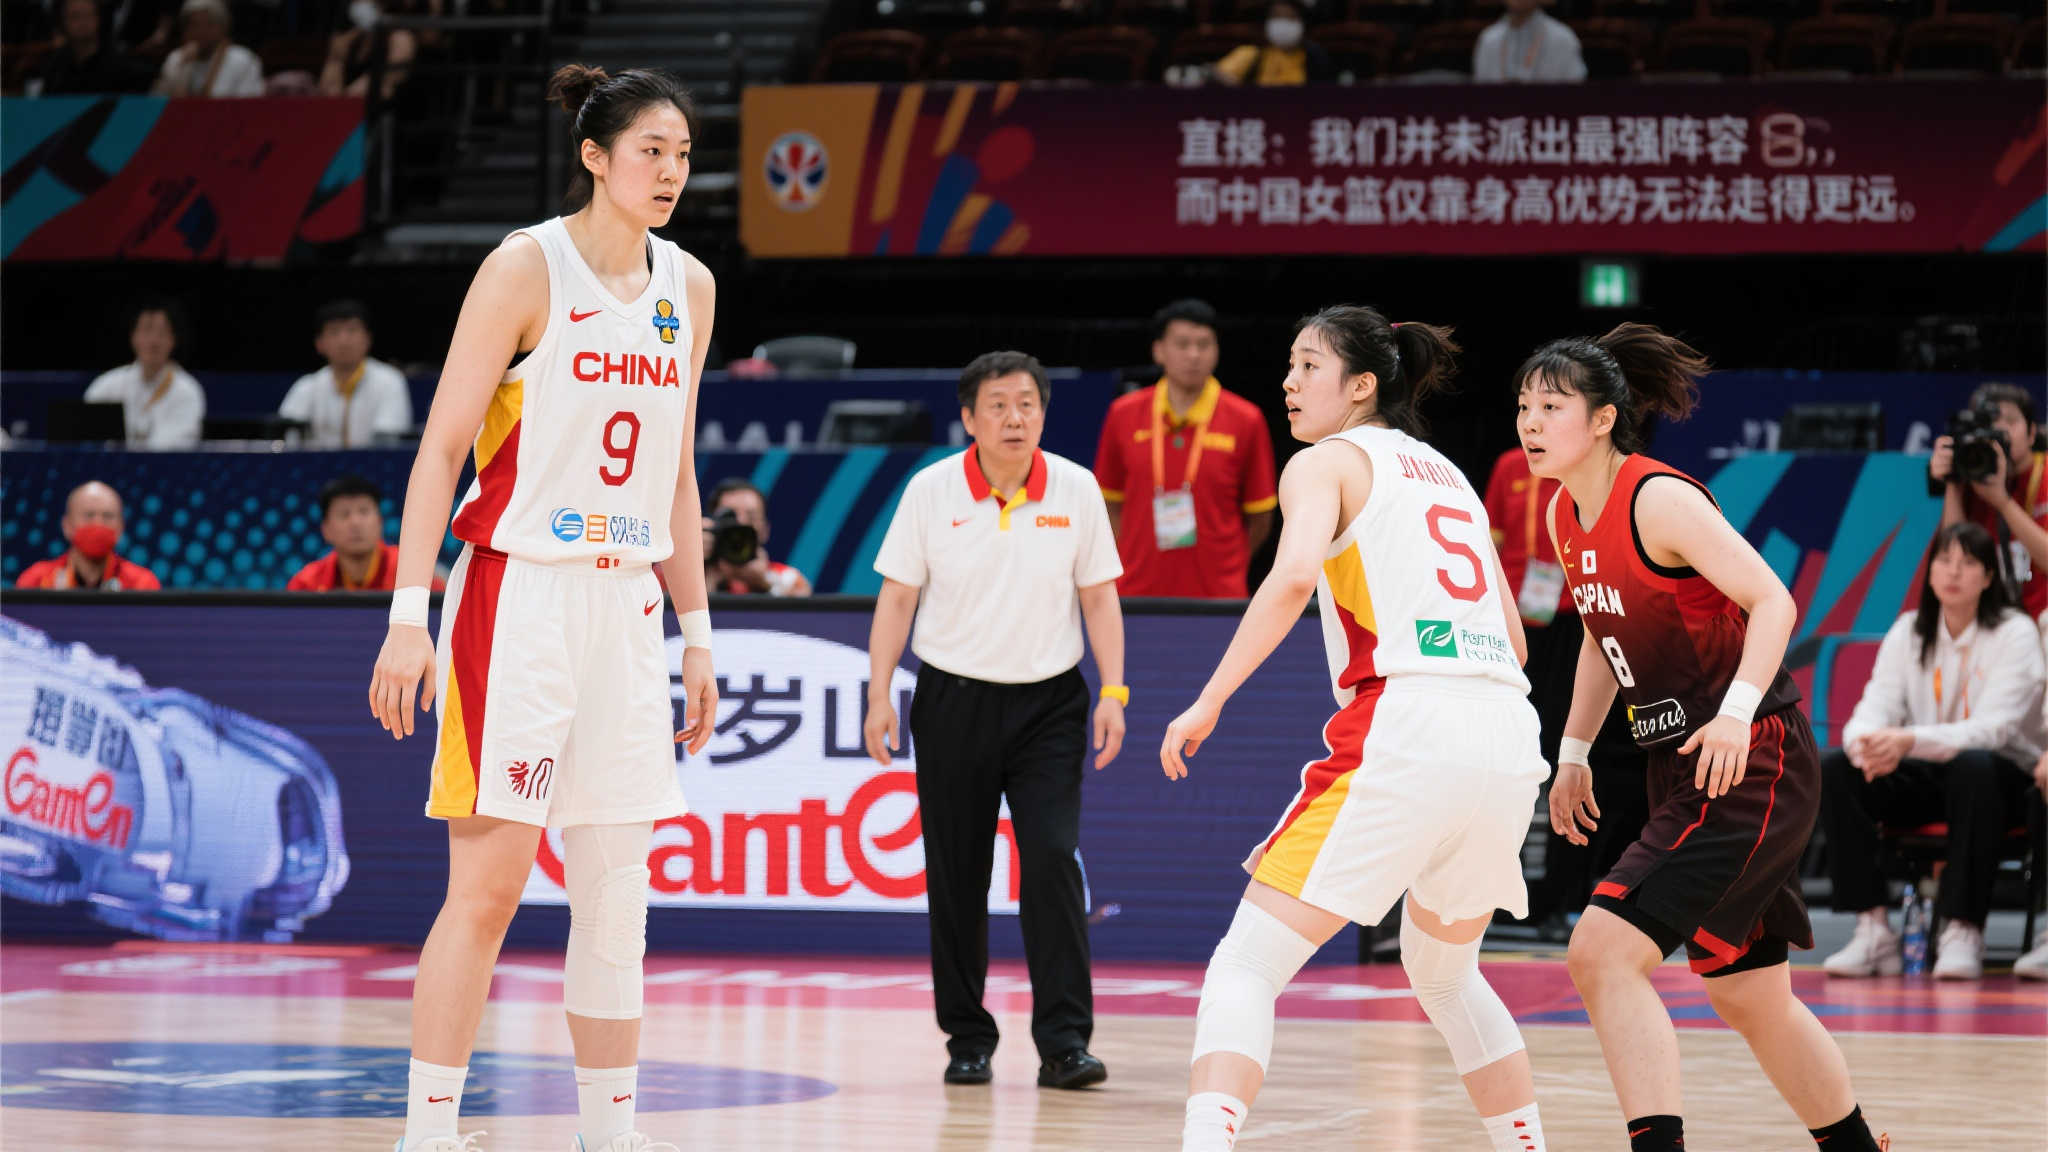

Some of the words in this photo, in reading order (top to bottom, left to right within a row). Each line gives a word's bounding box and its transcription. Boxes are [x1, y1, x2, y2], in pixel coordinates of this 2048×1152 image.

[573, 351, 680, 388] CHINA
[599, 411, 641, 486] 9
[1425, 504, 1488, 602] 5
[1602, 636, 1635, 688] 8
[671, 673, 913, 765] 岁山
[535, 769, 1021, 903] ante
